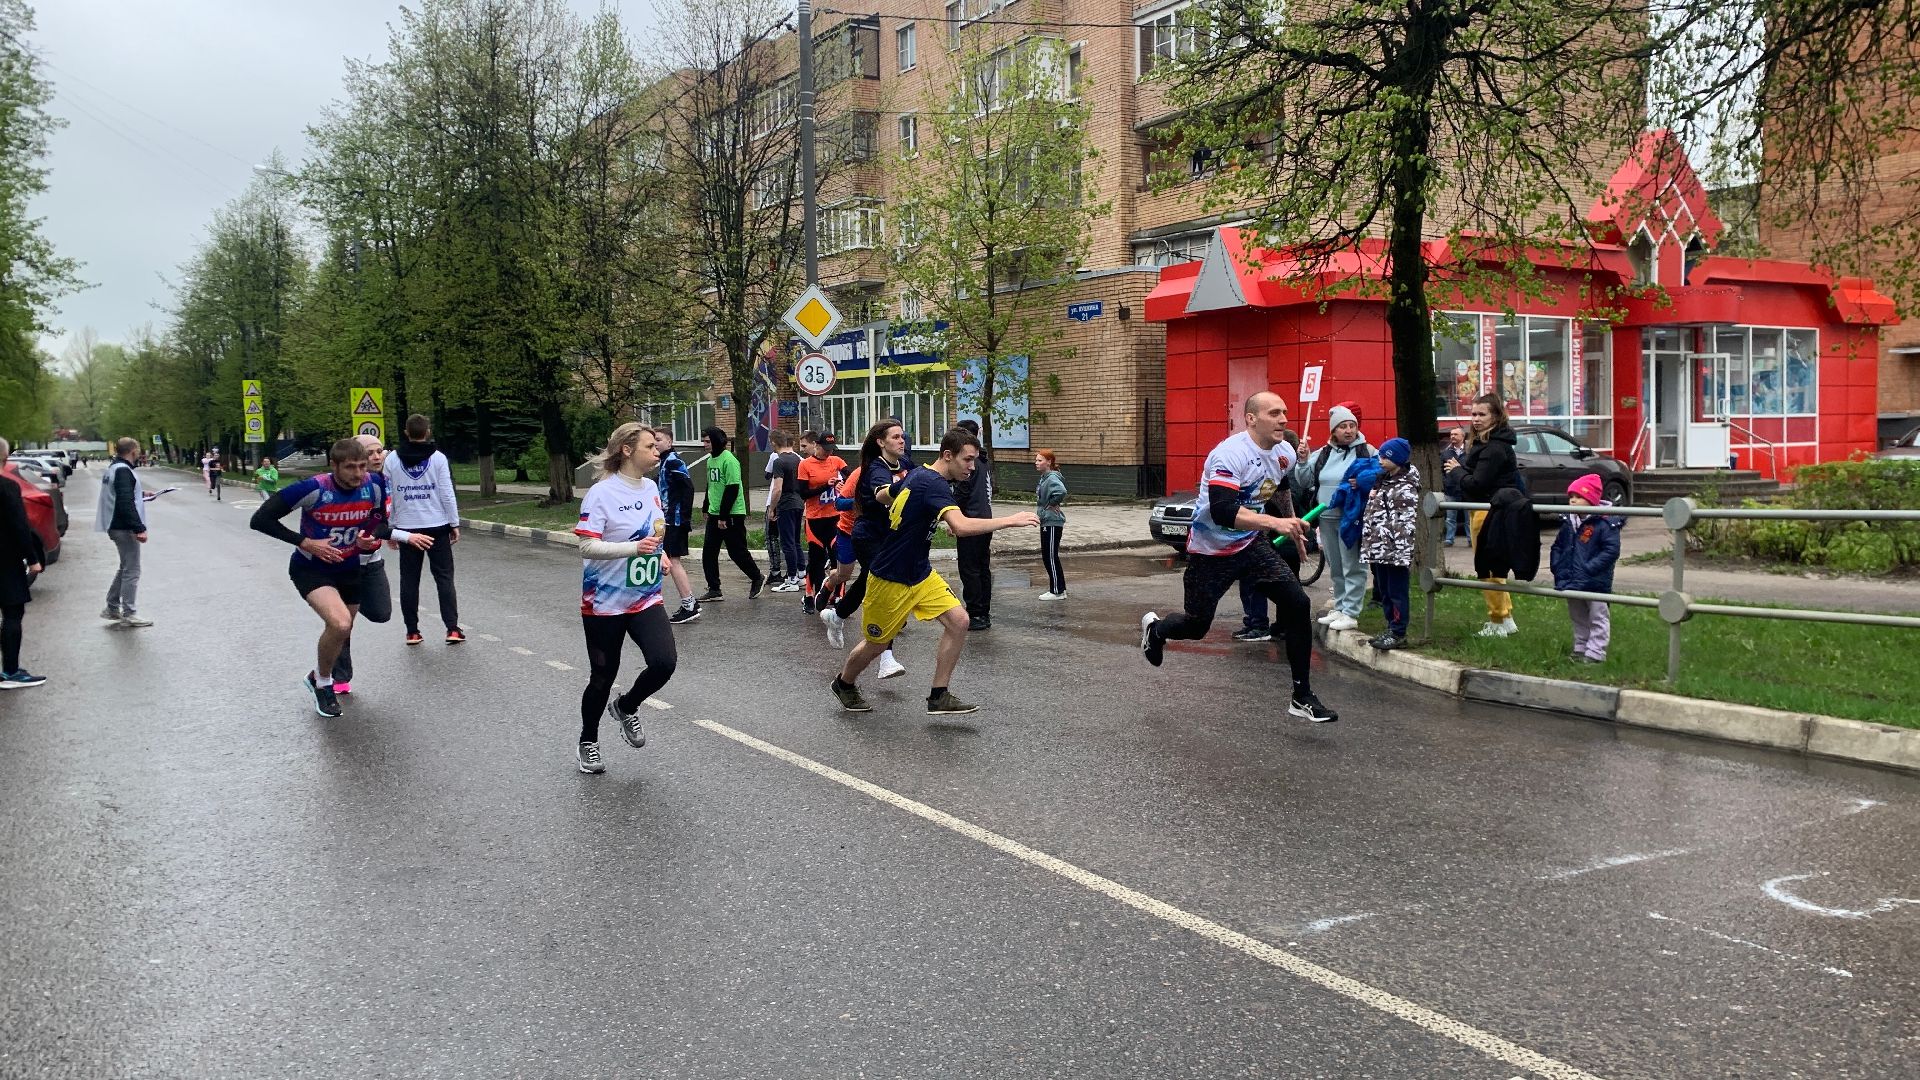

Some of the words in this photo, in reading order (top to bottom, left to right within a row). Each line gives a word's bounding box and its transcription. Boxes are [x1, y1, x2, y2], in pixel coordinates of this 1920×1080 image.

[1081, 312, 1088, 321] 21
[1306, 373, 1316, 393] 5
[1573, 338, 1582, 412] ПЕЛЬМЕНИ
[362, 427, 377, 437] 40
[710, 468, 719, 481] 61
[820, 488, 837, 504] 44
[328, 526, 360, 547] 50
[629, 556, 660, 586] 60
